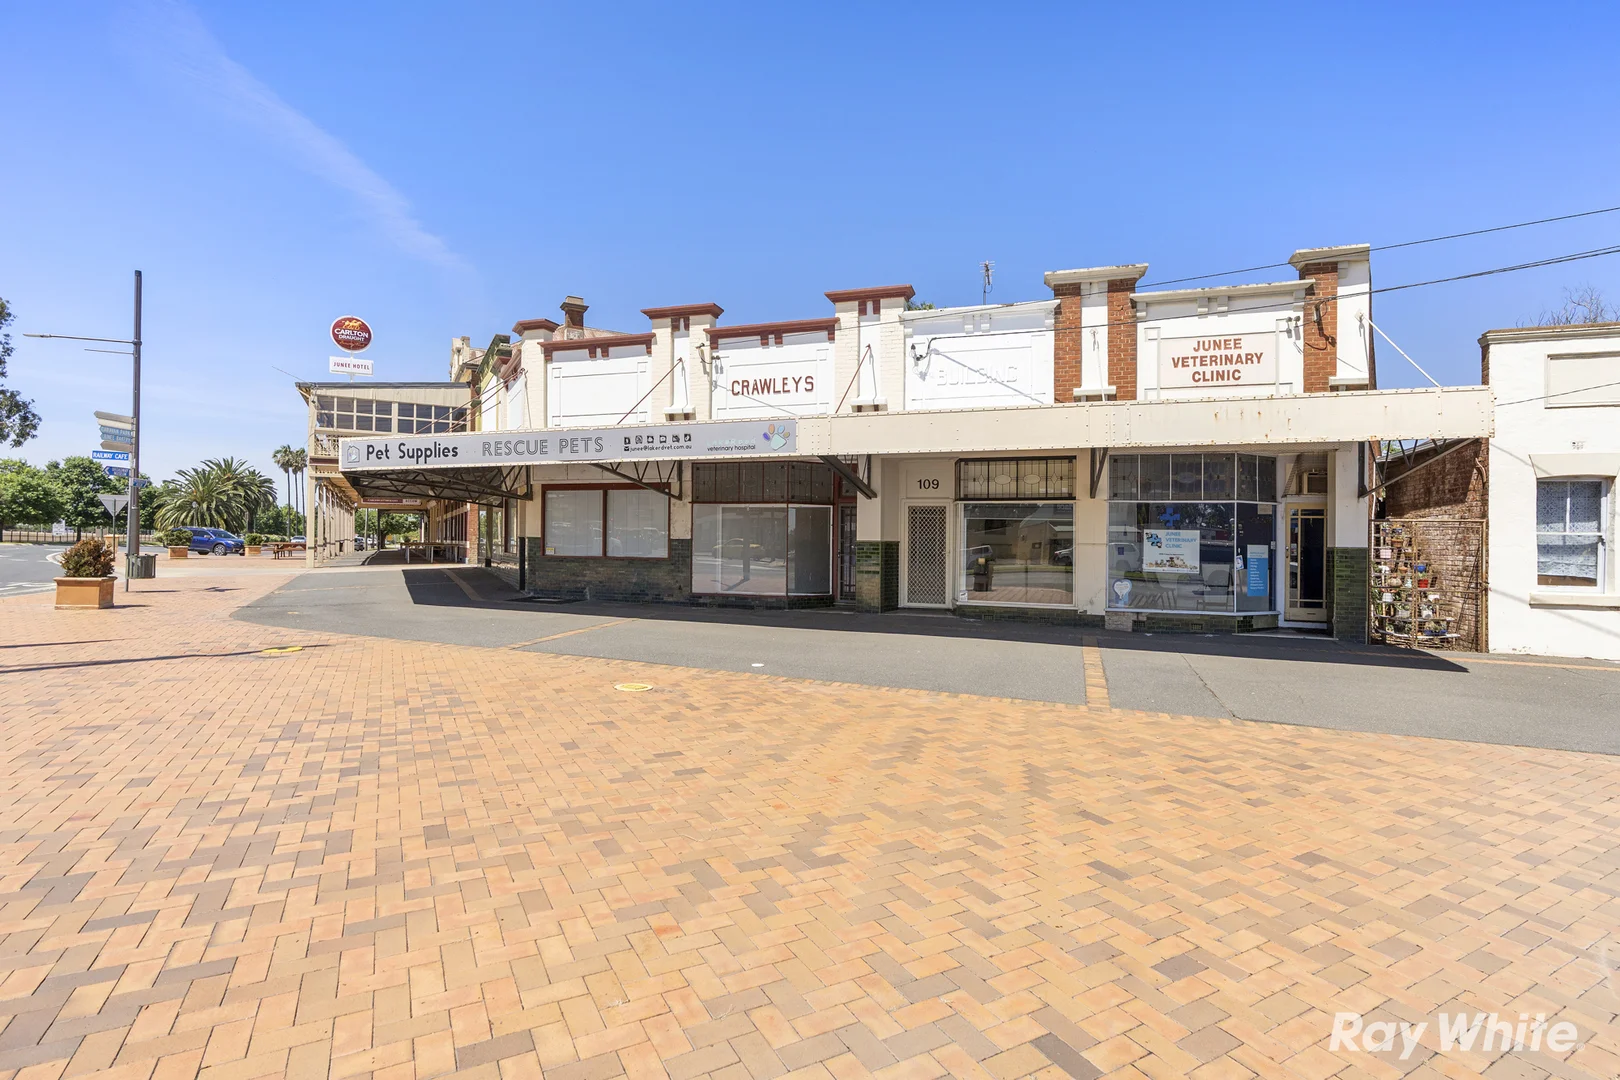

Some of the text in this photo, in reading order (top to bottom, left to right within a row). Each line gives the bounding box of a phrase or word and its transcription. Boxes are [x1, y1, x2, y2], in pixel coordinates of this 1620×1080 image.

[334, 328, 369, 338] CARLTON
[338, 334, 365, 342] DRAUGHT
[1193, 338, 1242, 352] JUNEE
[333, 361, 370, 371] JUNEE HOTEL
[1171, 352, 1264, 368] VETERINARY
[937, 366, 1018, 386] BUILDING
[1192, 369, 1242, 383] CLINIC
[731, 375, 814, 396] CRAWLEYS
[366, 437, 604, 464] Pet Supplies RESCUE PETS
[917, 479, 940, 490] 109
